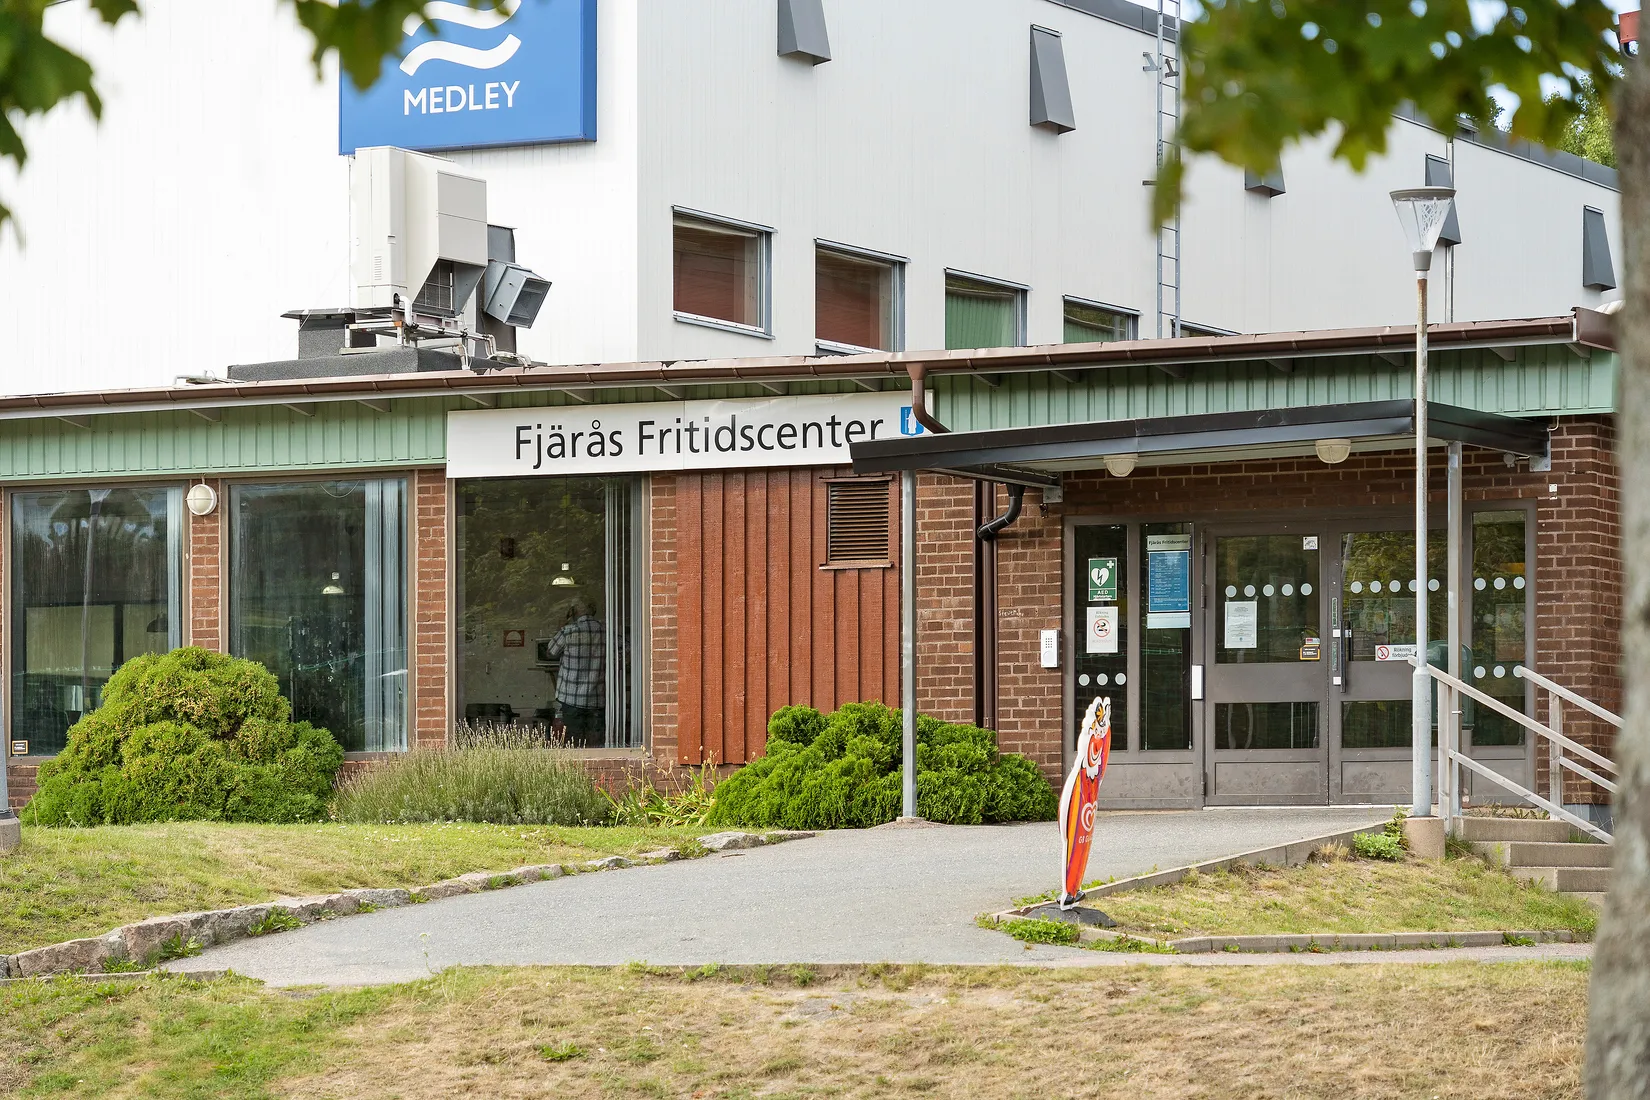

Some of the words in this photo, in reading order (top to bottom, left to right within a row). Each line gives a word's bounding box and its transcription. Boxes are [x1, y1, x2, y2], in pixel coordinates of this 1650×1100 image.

[403, 81, 520, 116] MEDLEY
[515, 419, 623, 469] Fjärås
[638, 414, 884, 456] Fritidscenter
